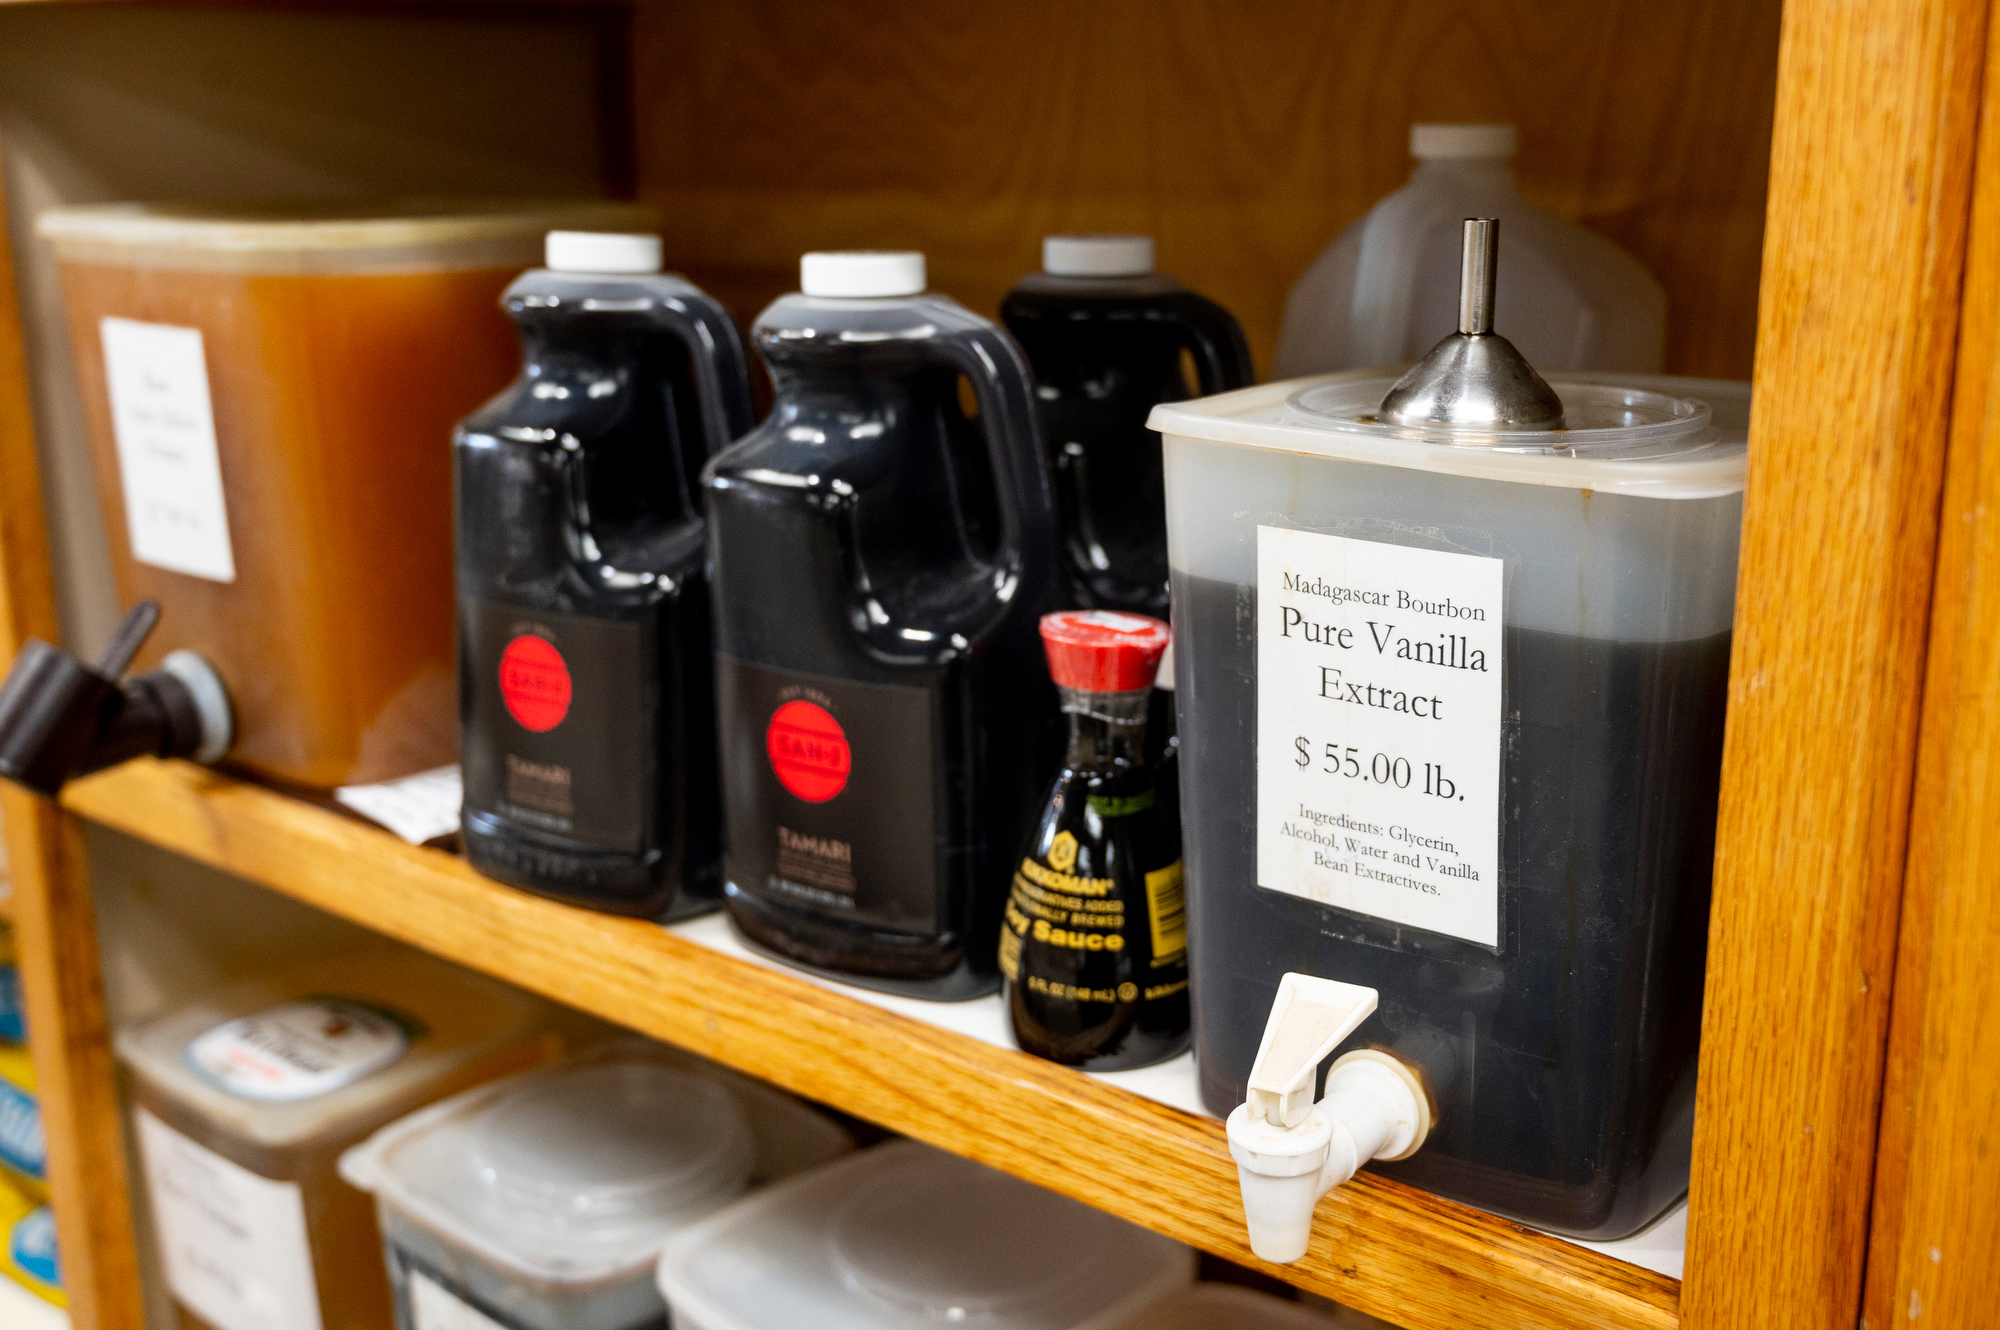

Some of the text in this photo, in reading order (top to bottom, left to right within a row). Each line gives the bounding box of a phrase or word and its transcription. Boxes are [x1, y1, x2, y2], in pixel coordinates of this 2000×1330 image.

[1282, 571, 1486, 622] Madagascar Bourbon
[1279, 605, 1489, 672] Pure Vanilla
[1317, 665, 1444, 720] Extract
[1294, 735, 1465, 802] $ 55.00 lb.
[777, 825, 852, 860] TAMARI
[1280, 821, 1480, 882] Alcohol, Water and Vanilla
[1299, 803, 1459, 857] Ingredients: Glycerin,
[1313, 850, 1441, 896] Bean Extractives.
[1032, 918, 1125, 952] Sauce
